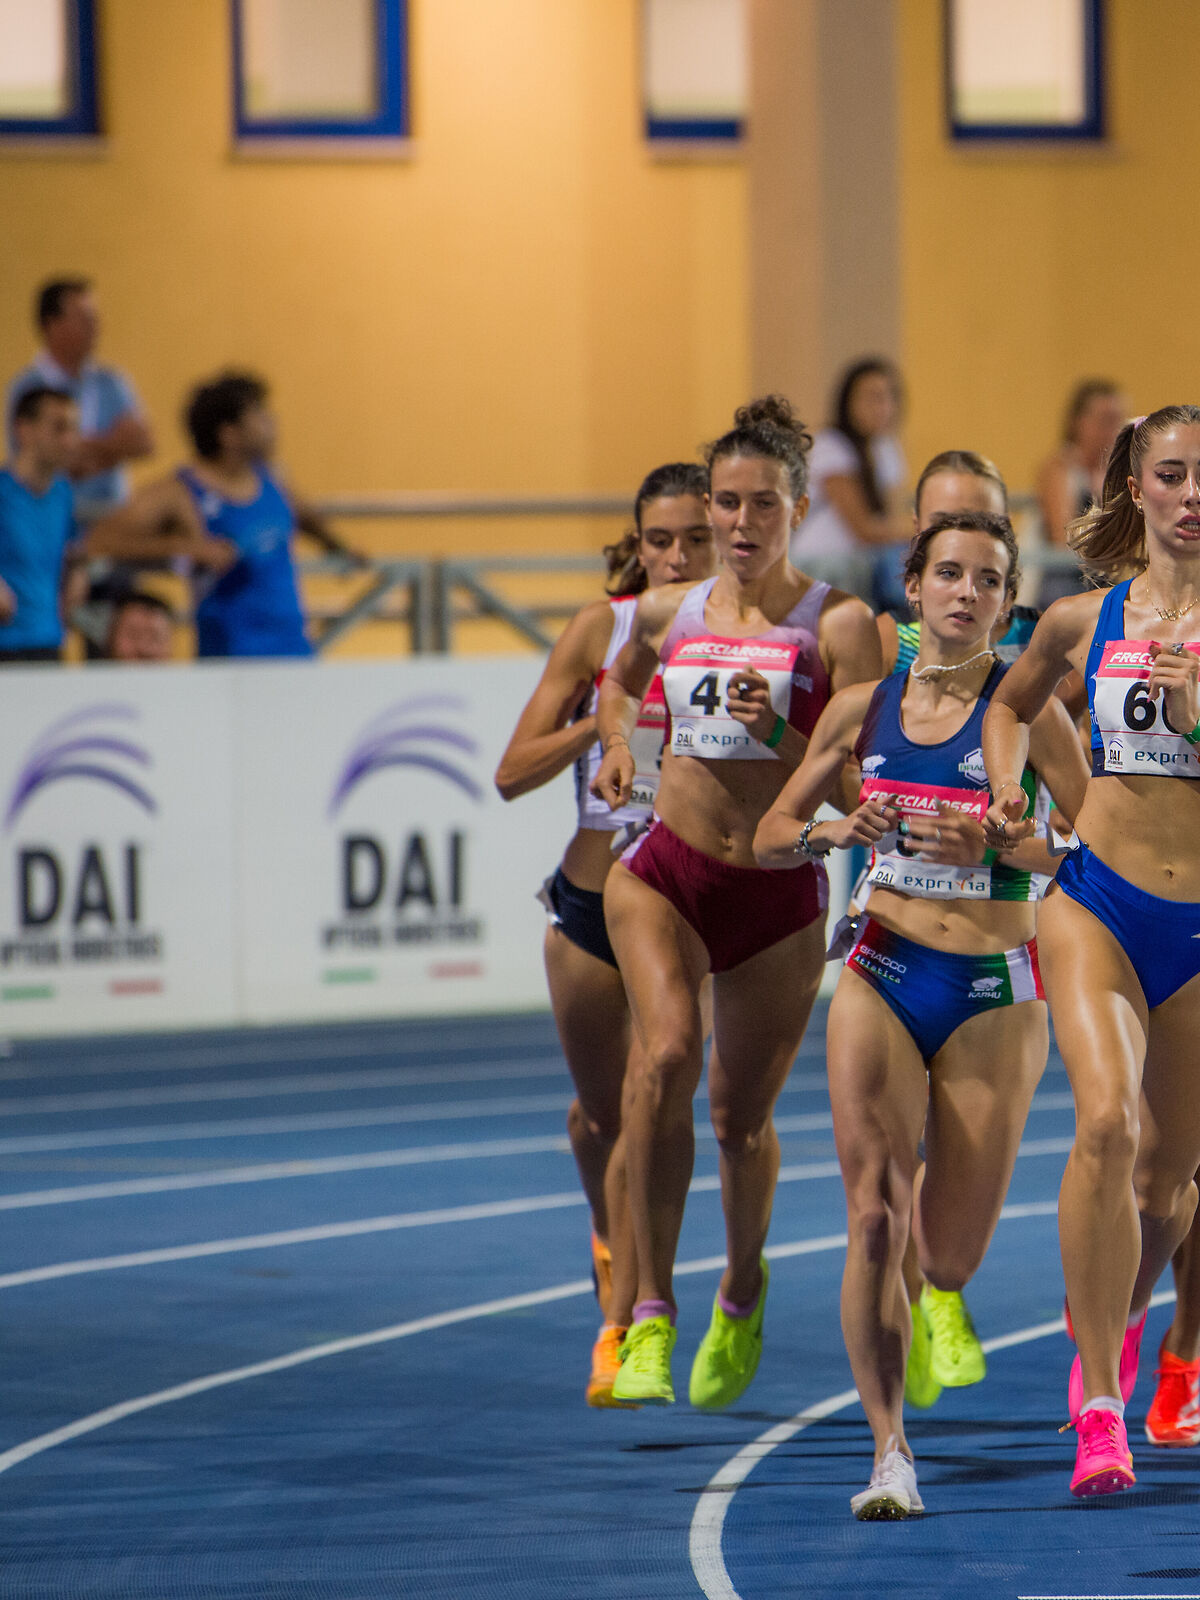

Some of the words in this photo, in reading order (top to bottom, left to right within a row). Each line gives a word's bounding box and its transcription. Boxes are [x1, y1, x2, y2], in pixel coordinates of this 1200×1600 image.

[677, 733, 693, 745] DAI
[701, 734, 750, 747] expri
[1135, 751, 1200, 766] expri
[342, 829, 466, 914] DAI
[875, 871, 894, 885] DAI
[904, 873, 985, 892] exprivia
[17, 842, 141, 928] DAI
